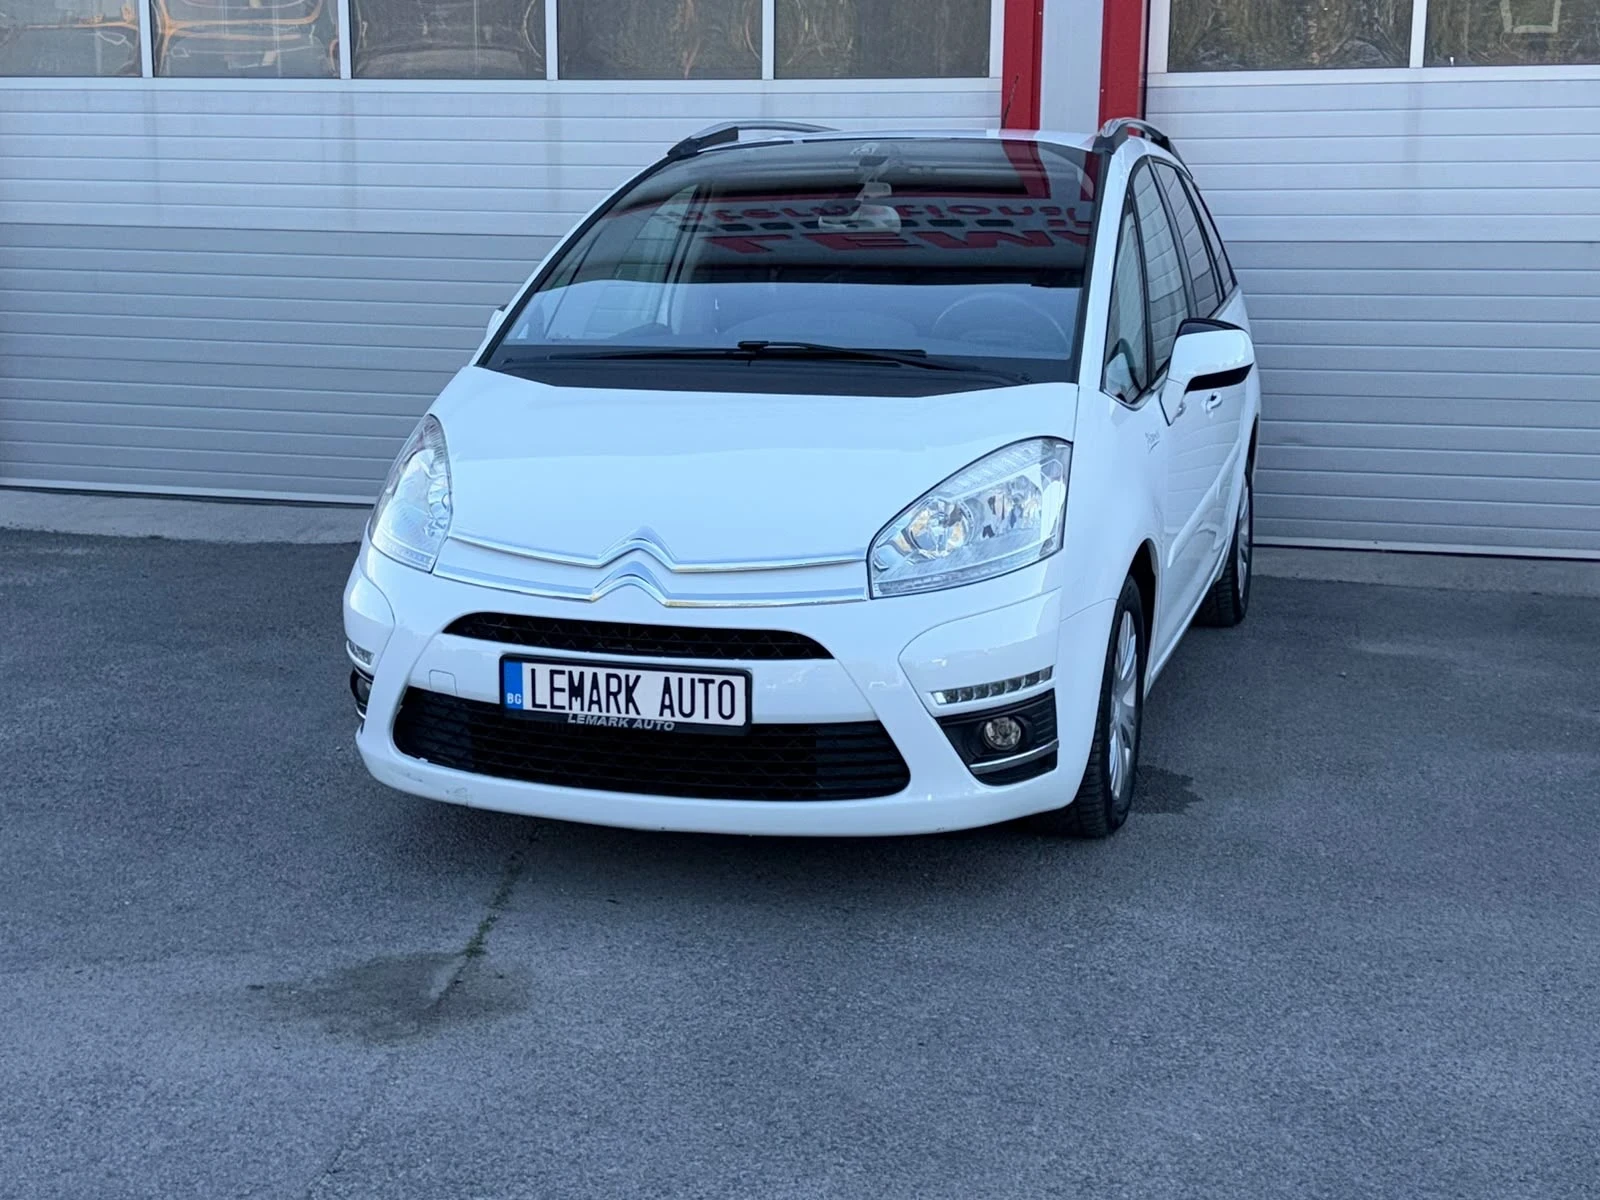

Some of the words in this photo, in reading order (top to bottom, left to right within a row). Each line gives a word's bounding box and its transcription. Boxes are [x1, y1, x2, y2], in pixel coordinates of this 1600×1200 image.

[506, 692, 523, 705] BG
[530, 668, 642, 716] LEMARK
[658, 676, 736, 721] AUTO
[567, 713, 630, 729] LEMARK
[632, 719, 676, 732] AUTO
